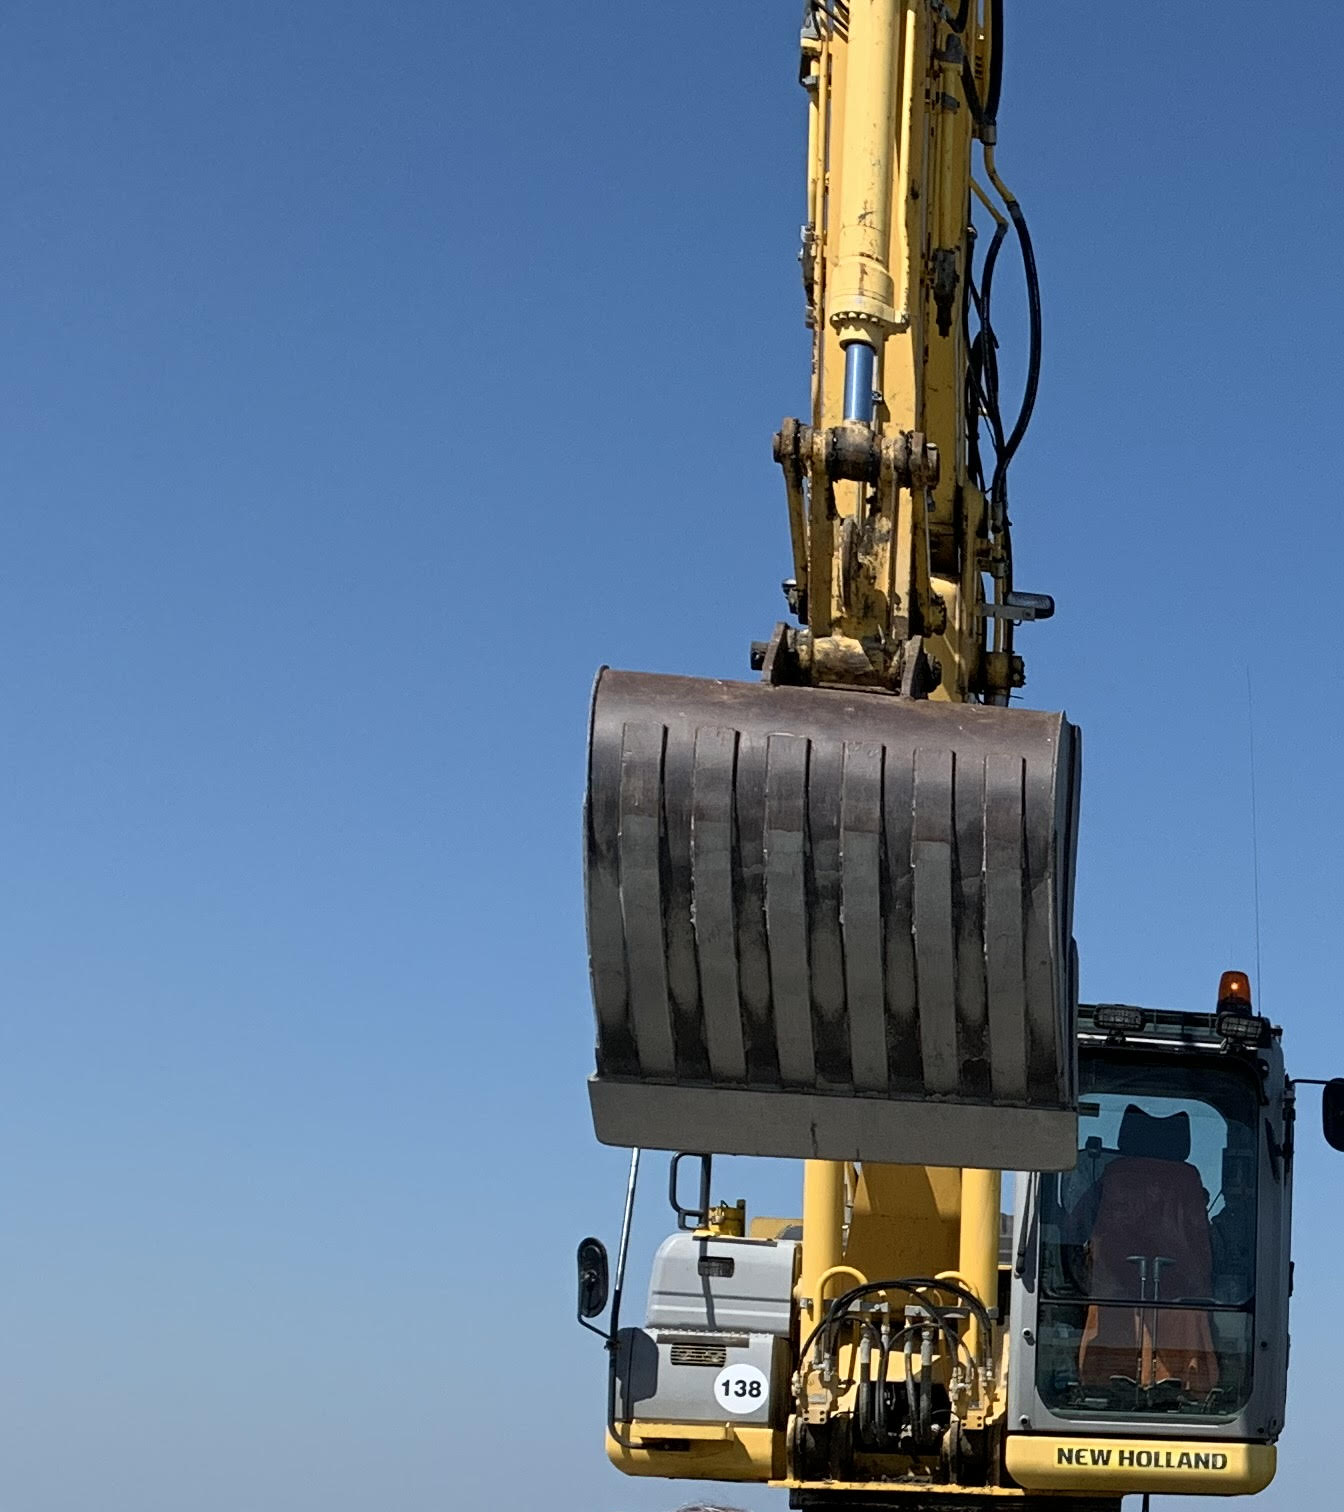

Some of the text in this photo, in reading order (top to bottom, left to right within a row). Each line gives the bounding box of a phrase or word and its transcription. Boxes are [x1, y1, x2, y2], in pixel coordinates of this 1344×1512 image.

[721, 1379, 762, 1398] 138
[1057, 1447, 1228, 1470] NEW HOLLAND
